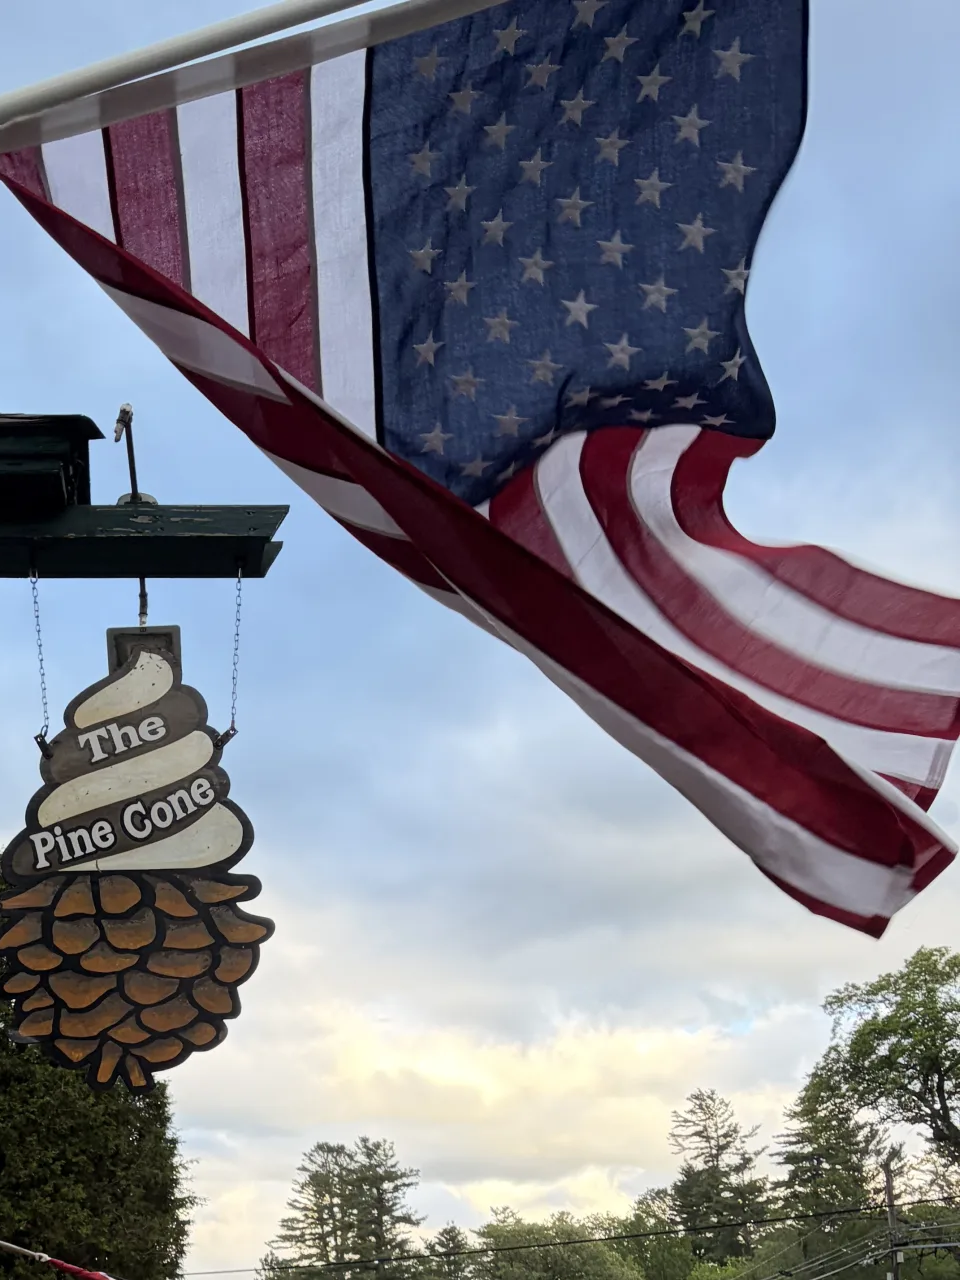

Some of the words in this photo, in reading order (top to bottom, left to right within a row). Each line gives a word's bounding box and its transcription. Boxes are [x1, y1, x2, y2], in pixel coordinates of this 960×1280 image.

[78, 716, 166, 763] The
[30, 820, 115, 869] Pine
[123, 777, 215, 839] Cone
